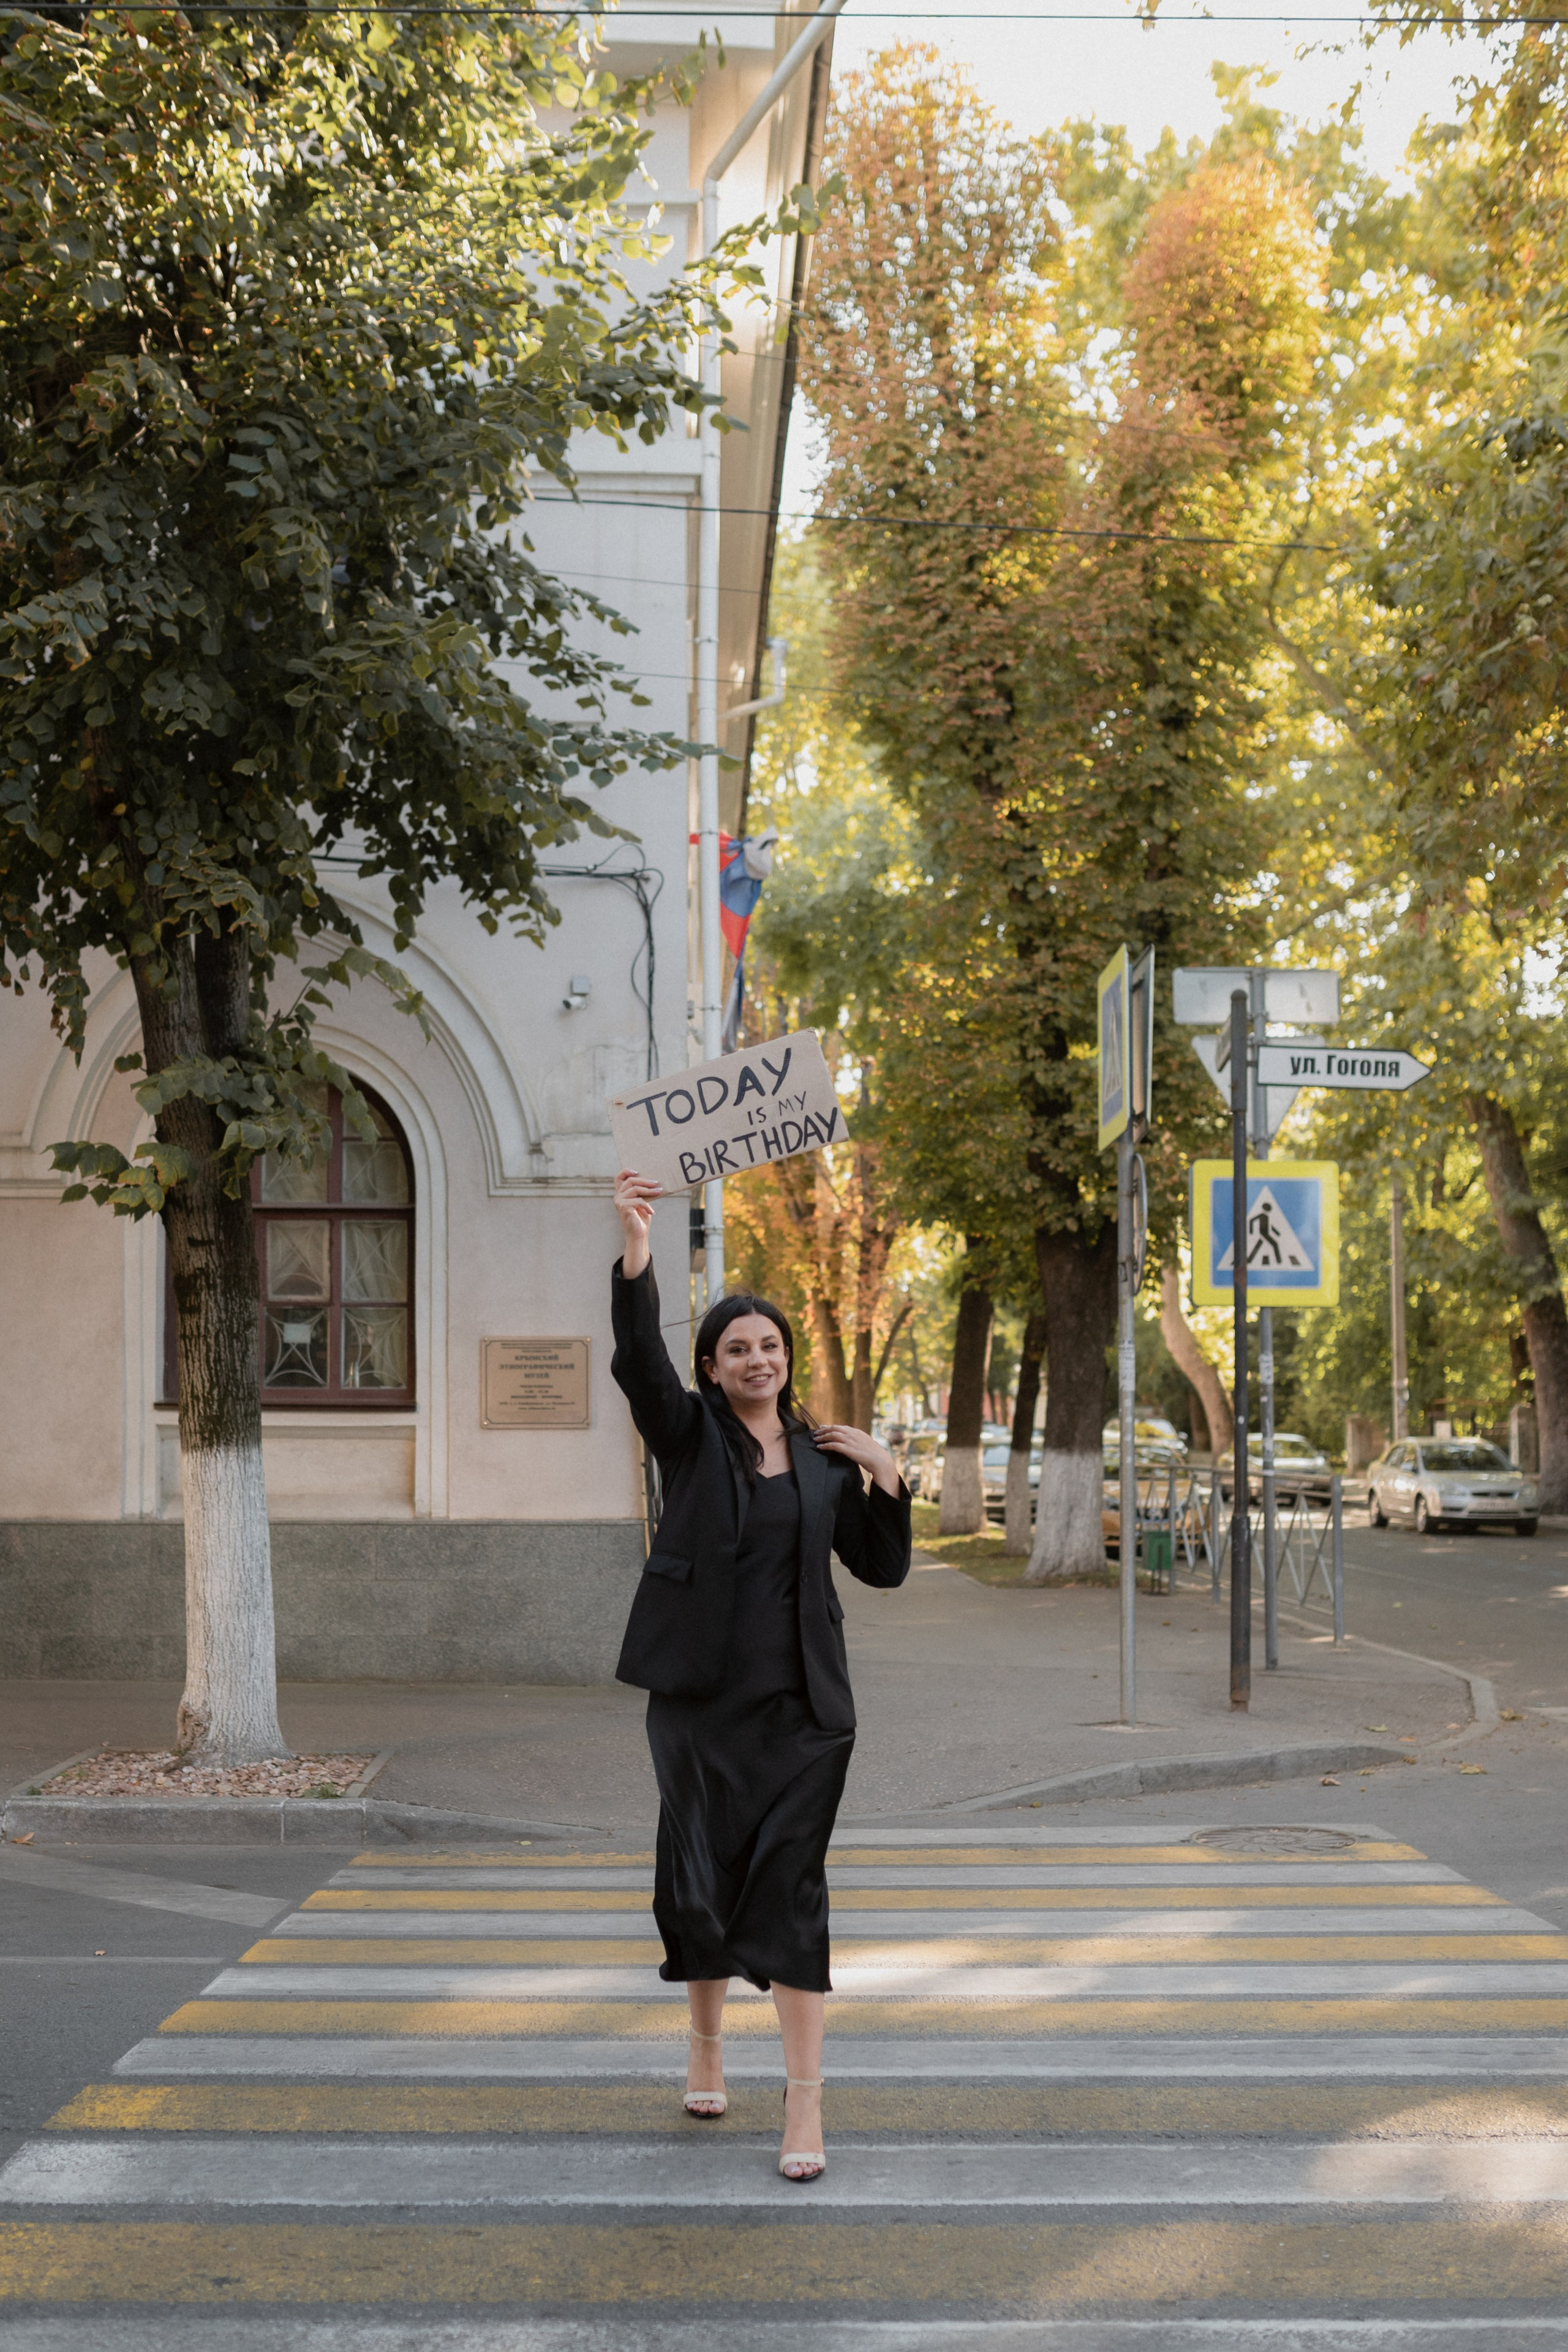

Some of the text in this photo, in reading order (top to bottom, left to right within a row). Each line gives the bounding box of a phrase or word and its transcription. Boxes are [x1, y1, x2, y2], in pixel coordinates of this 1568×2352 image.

[626, 1047, 791, 1136] TODAY
[1291, 1054, 1400, 1077] ул. Гоголя
[747, 1091, 806, 1125] IS MY
[679, 1107, 837, 1184] BIRTHDAY
